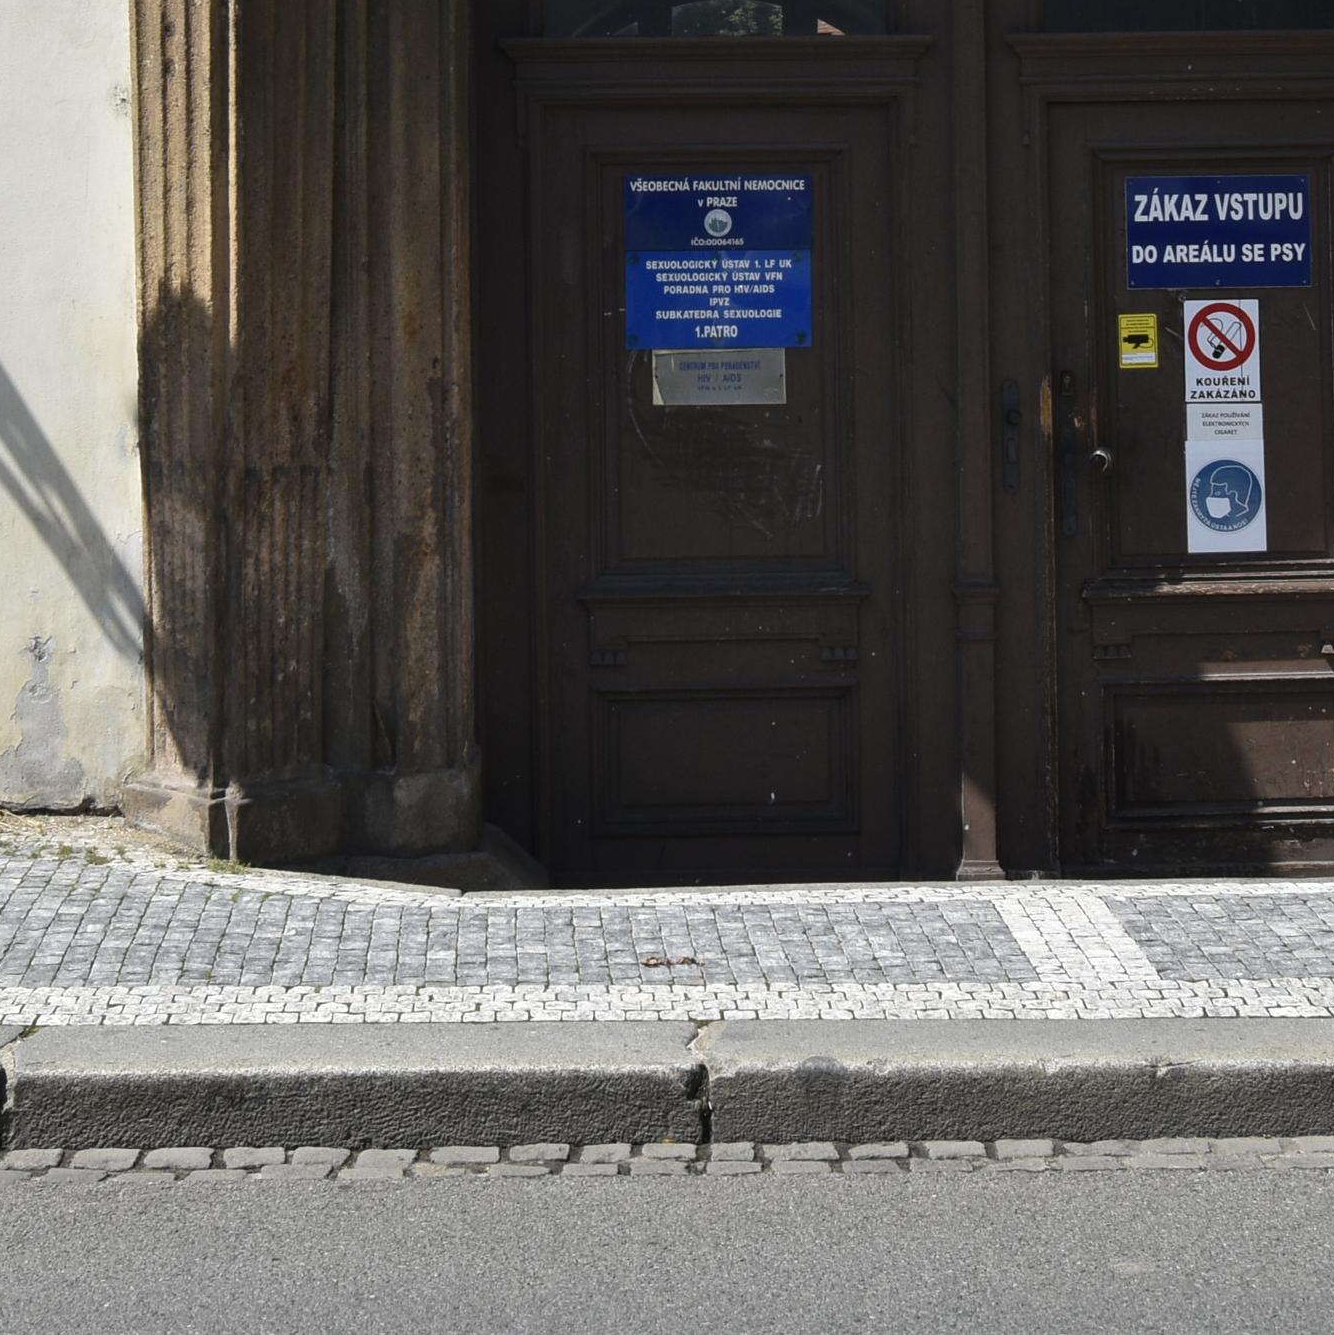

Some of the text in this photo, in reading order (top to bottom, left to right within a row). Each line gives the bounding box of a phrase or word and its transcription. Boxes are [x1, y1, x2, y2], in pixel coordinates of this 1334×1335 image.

[629, 176, 805, 192] VŠEOBECNÁ FAKULTNÍ NEMOCNICE
[697, 196, 738, 208] v PRAZE
[1133, 188, 1303, 222] ZÁKAZ VSTUPU
[691, 237, 744, 246] IČO:00064165
[1131, 240, 1306, 264] DO AREÁLU SE PSY
[646, 258, 792, 269] SEXUOLOGICKÝ ÚSTAV 1. LF UK
[656, 270, 783, 282] SEXUOLOGICKÝ ÚSTAV VFN
[663, 284, 775, 294] PORADNA PRO HIV/AIDS
[709, 298, 730, 306] IPVZ
[655, 309, 782, 320] SUBKATEDRA SEXUOLOGIE
[695, 325, 738, 338] 1.PATRO
[697, 373, 710, 383] HIV
[723, 373, 742, 383] AIDS
[1196, 375, 1250, 386] KOUŘENÍ
[1190, 388, 1256, 399] ZAKÁZÁNO
